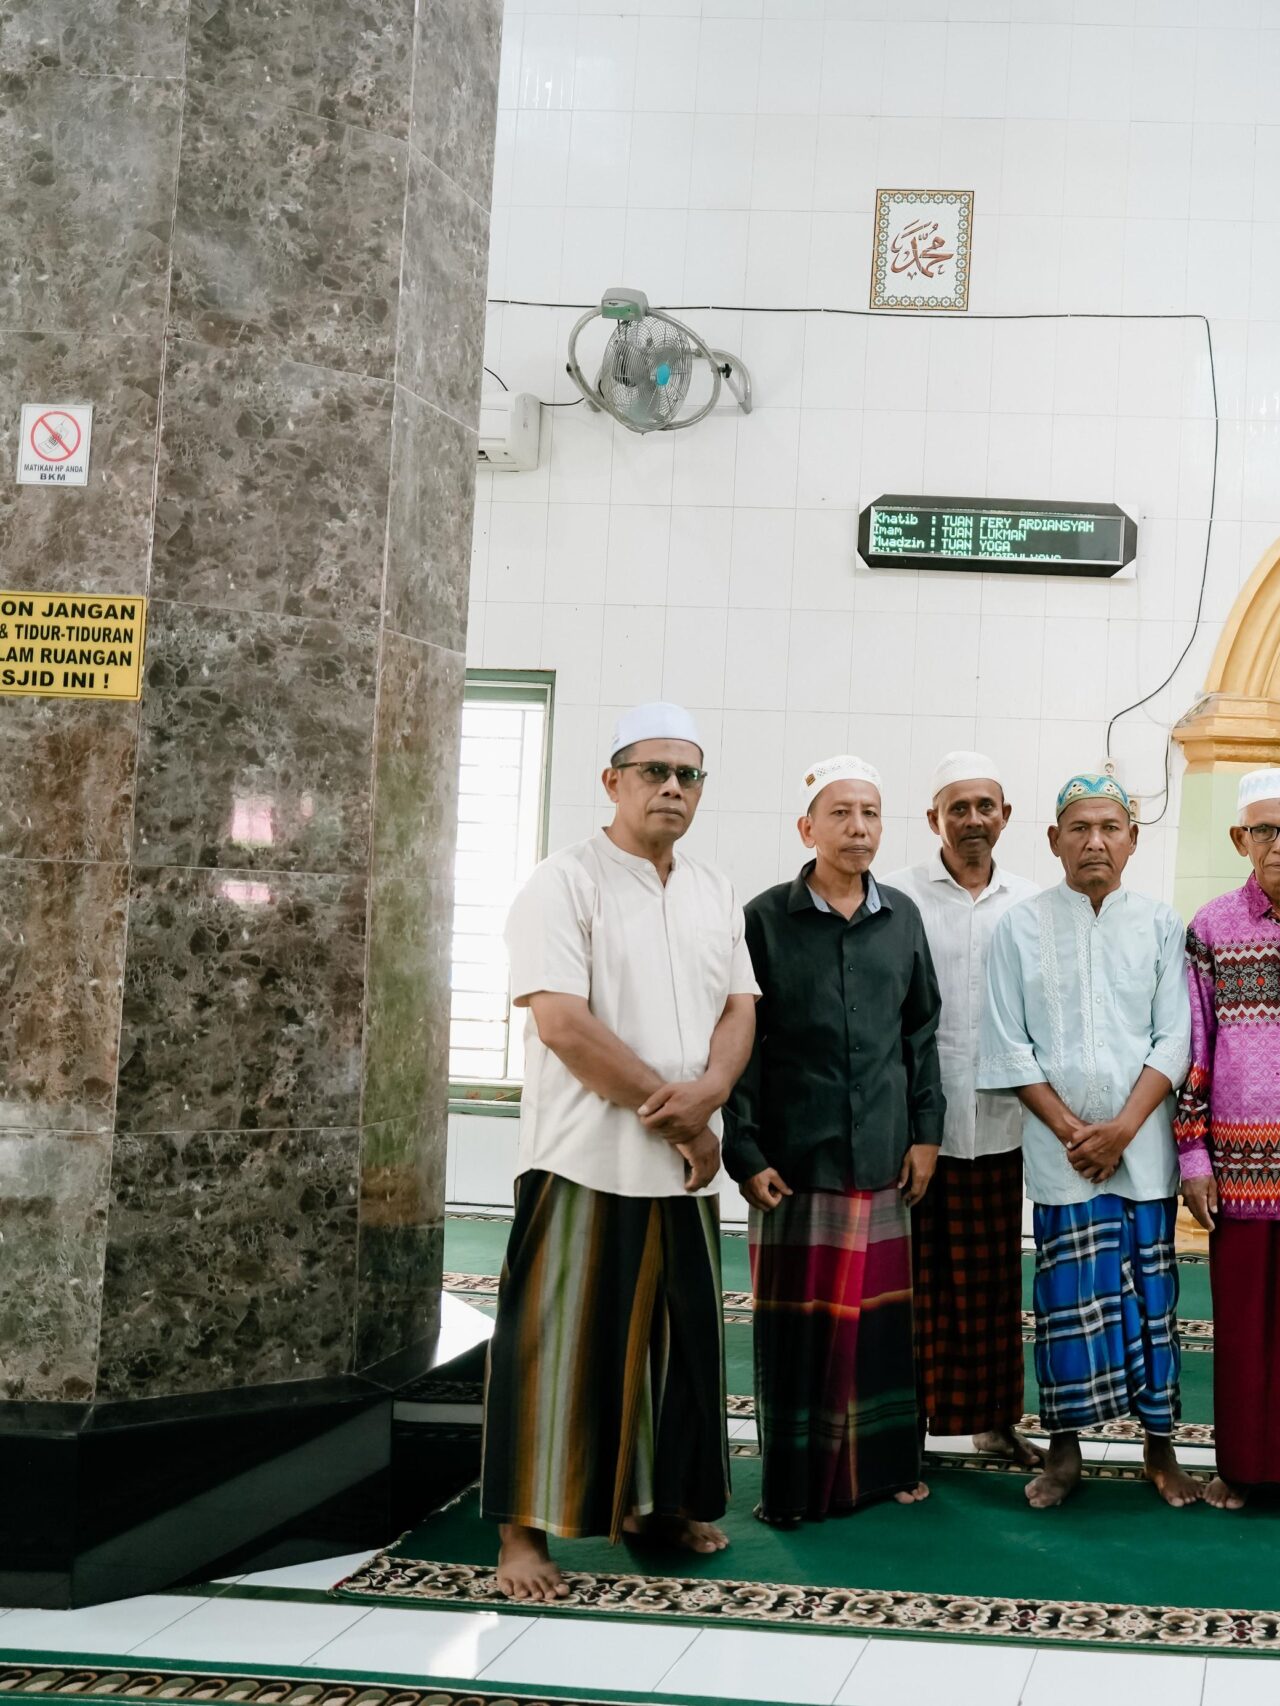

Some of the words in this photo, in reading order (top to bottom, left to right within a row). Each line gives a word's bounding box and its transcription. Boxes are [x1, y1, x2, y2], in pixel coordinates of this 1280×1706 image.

[874, 511, 918, 525] Khatib
[942, 515, 973, 527] TUAN
[980, 517, 1012, 528] FERY
[1019, 518, 1095, 533] ARDIANSYAH
[873, 524, 902, 535] Imam
[942, 527, 972, 538] TUAN
[979, 528, 1026, 541] LUKMAN
[873, 535, 925, 549] Muadzin
[941, 538, 972, 550] TUAN
[979, 540, 1011, 552] YOGA
[42, 602, 135, 620] JANGAN
[15, 624, 133, 643] TIDUR-TIDURAN
[40, 647, 132, 666] RUANGAN
[63, 671, 94, 688] INI
[104, 673, 109, 688] !
